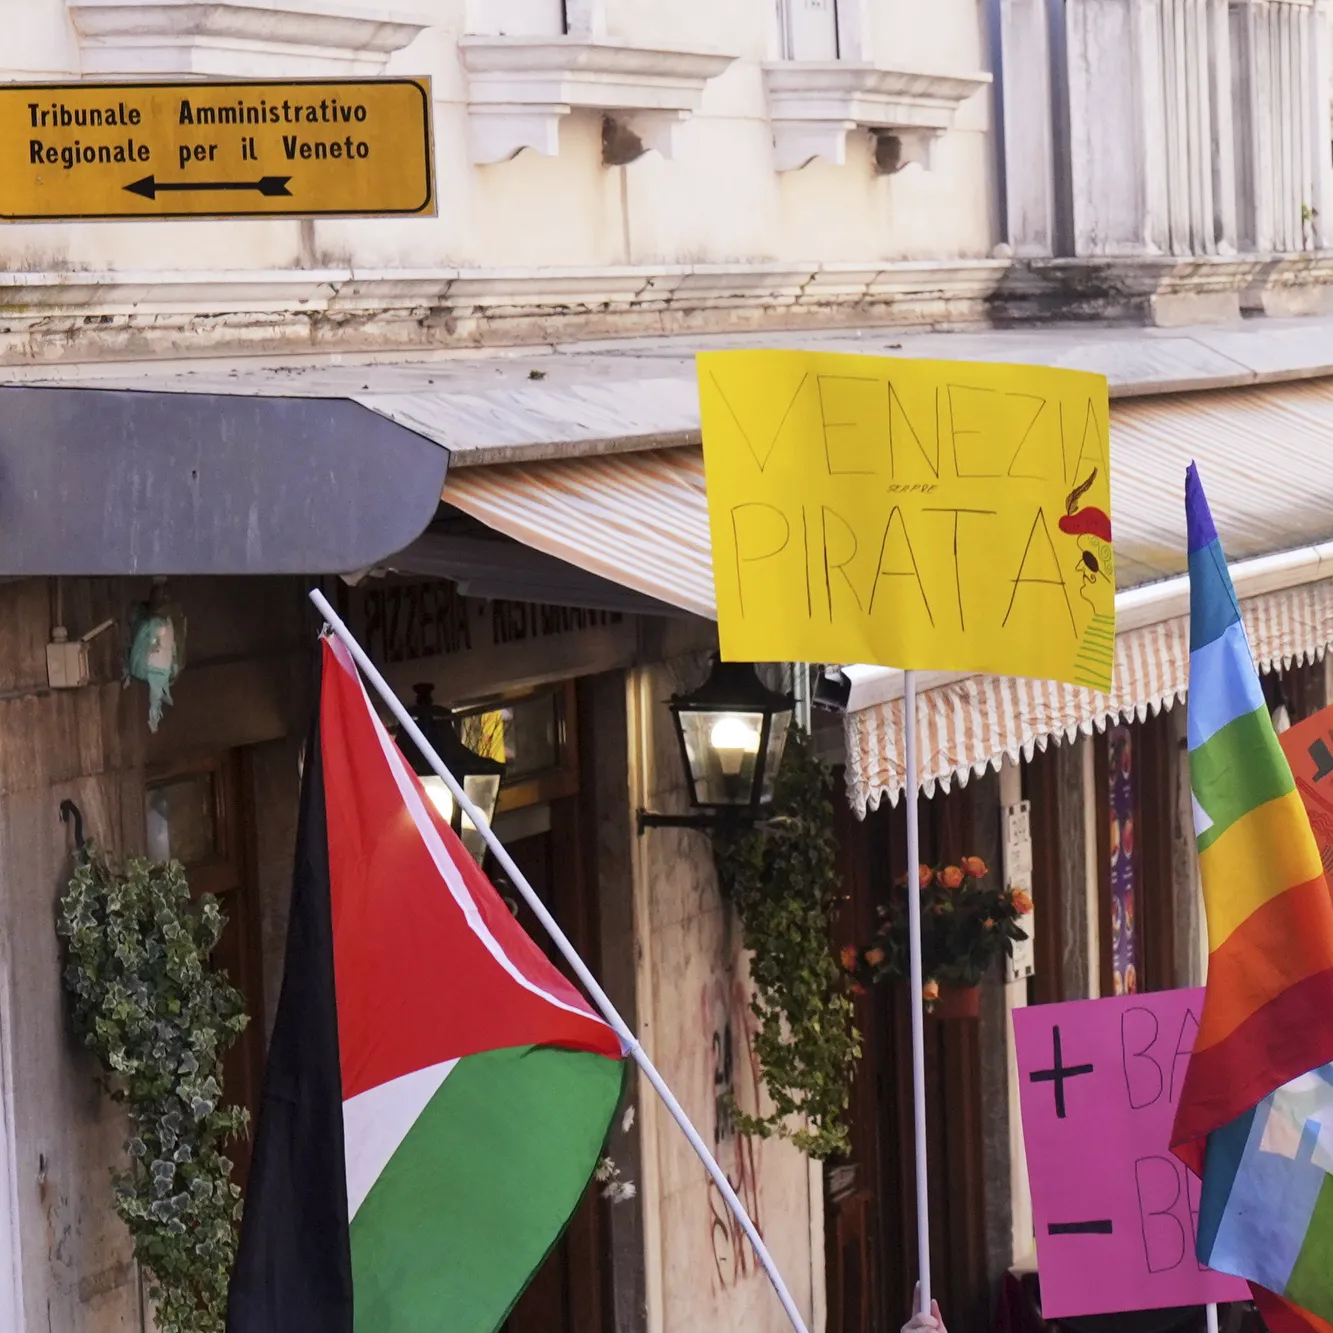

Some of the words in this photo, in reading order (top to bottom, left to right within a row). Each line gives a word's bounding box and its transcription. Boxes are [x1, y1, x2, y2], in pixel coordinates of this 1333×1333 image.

[28, 102, 142, 128] Tribunale
[179, 99, 368, 125] Amministrativo
[29, 138, 151, 169] Regionale
[179, 141, 218, 169] per
[242, 137, 258, 161] il
[282, 135, 370, 160] Veneto
[709, 370, 1111, 490] VENEZIA
[731, 504, 1079, 638] PIRATA
